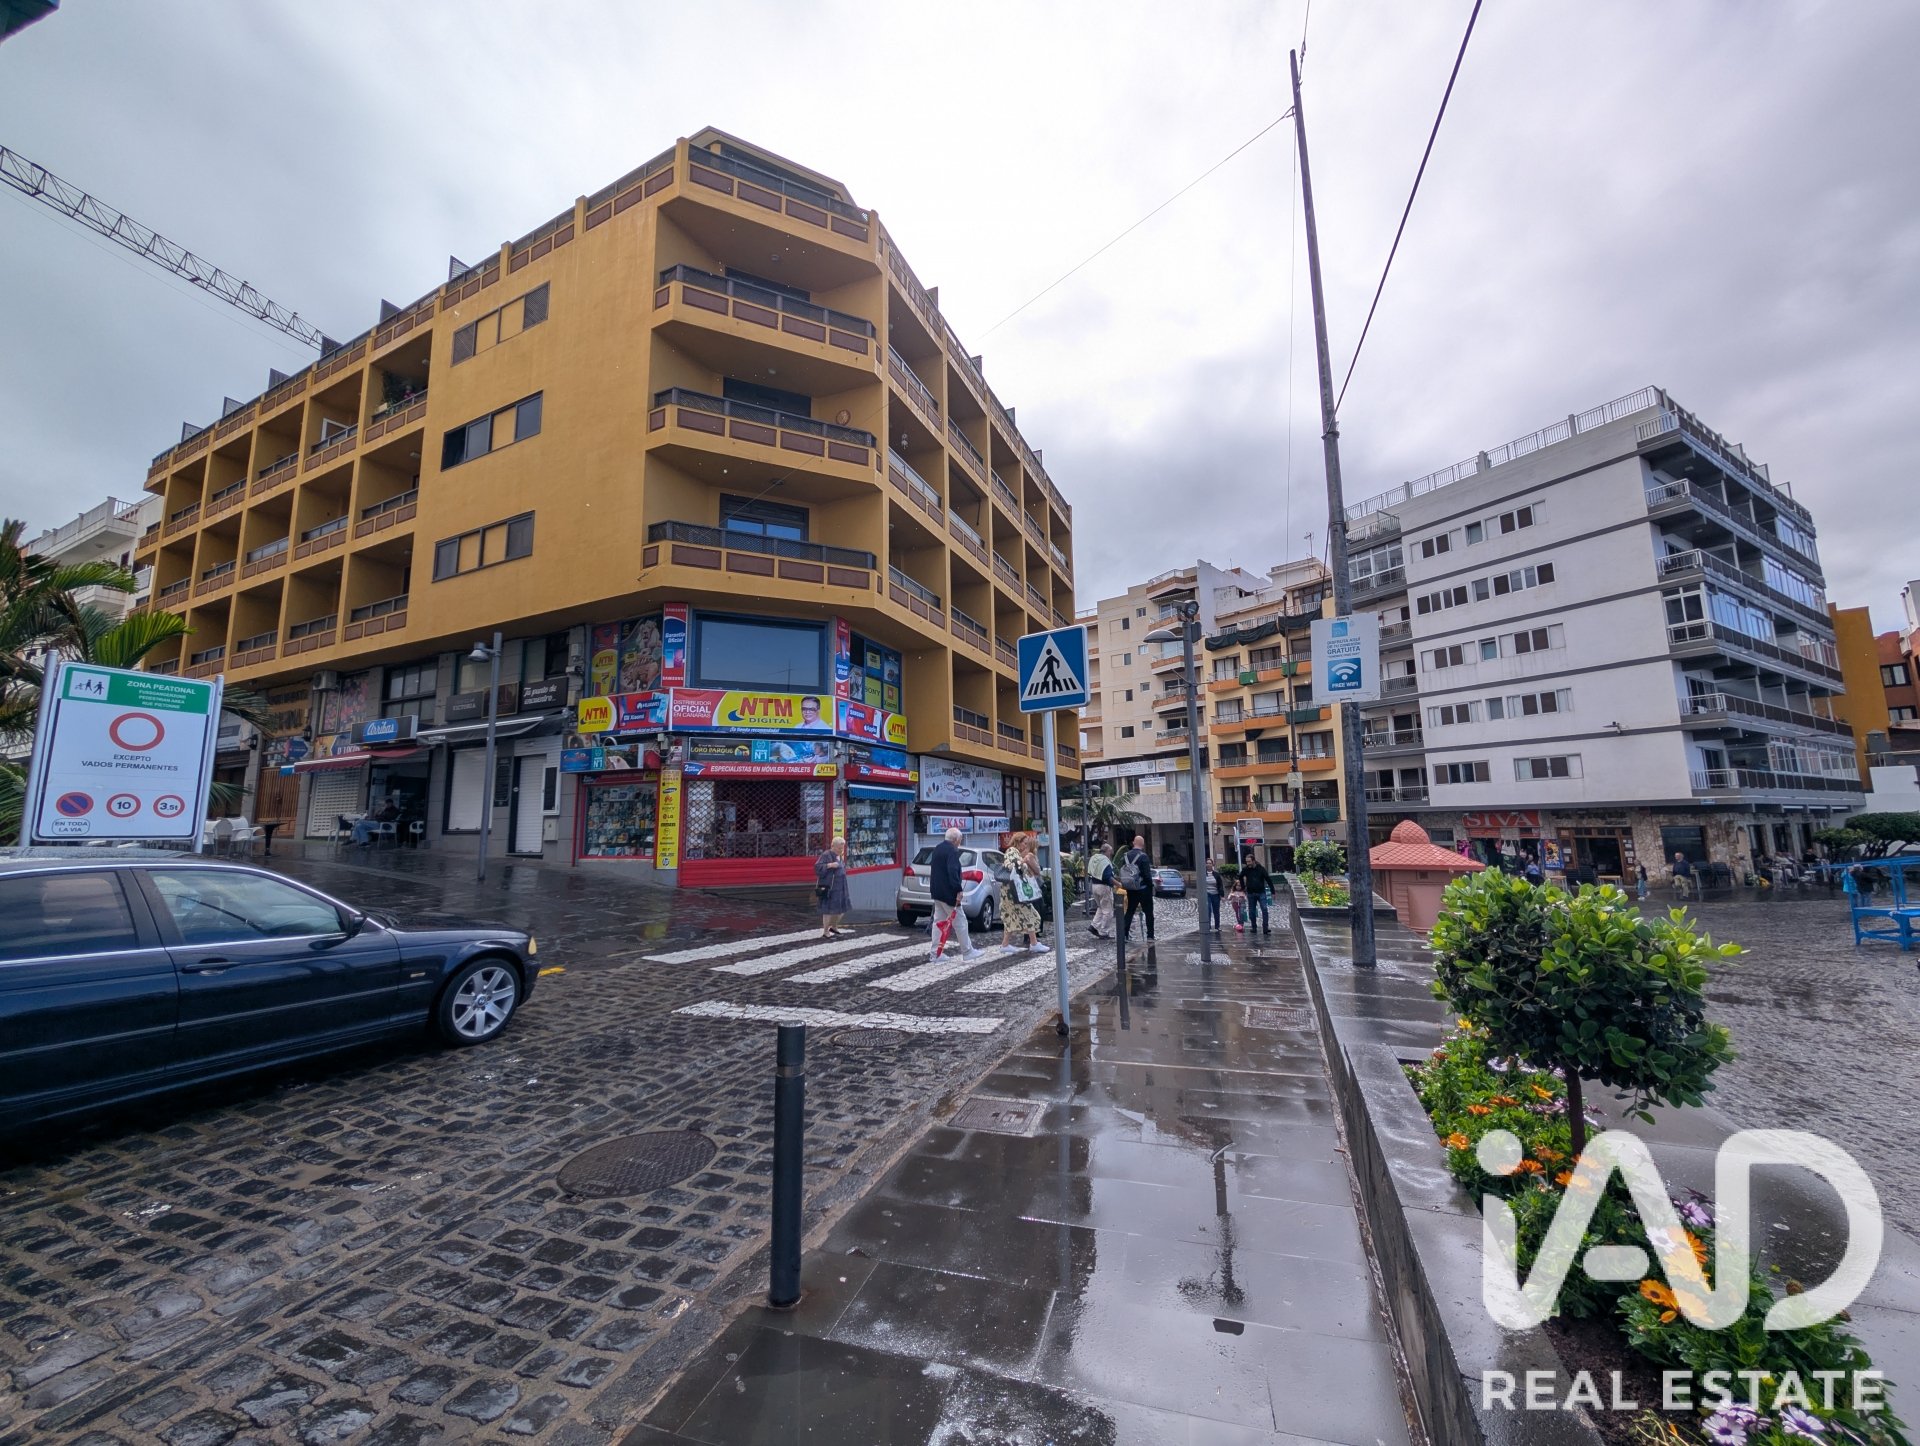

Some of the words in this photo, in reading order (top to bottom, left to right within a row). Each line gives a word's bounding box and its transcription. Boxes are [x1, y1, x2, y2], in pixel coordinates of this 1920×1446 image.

[1327, 646, 1361, 655] GRATUITA
[127, 680, 152, 690] ZONA
[153, 684, 197, 695] PEATONAL
[673, 705, 711, 713] OFICIAL
[739, 697, 792, 717] NTM
[585, 707, 608, 720] NTM
[367, 720, 394, 735] Arribas
[891, 723, 905, 734] NTM
[114, 754, 151, 762] EXCEPTO
[115, 762, 178, 771] PERMANENTES
[762, 765, 784, 773] MÓVILES
[117, 801, 131, 810] 10
[160, 803, 178, 811] 3.5t
[941, 818, 967, 829] AKASI
[1467, 812, 1533, 827] SIVA
